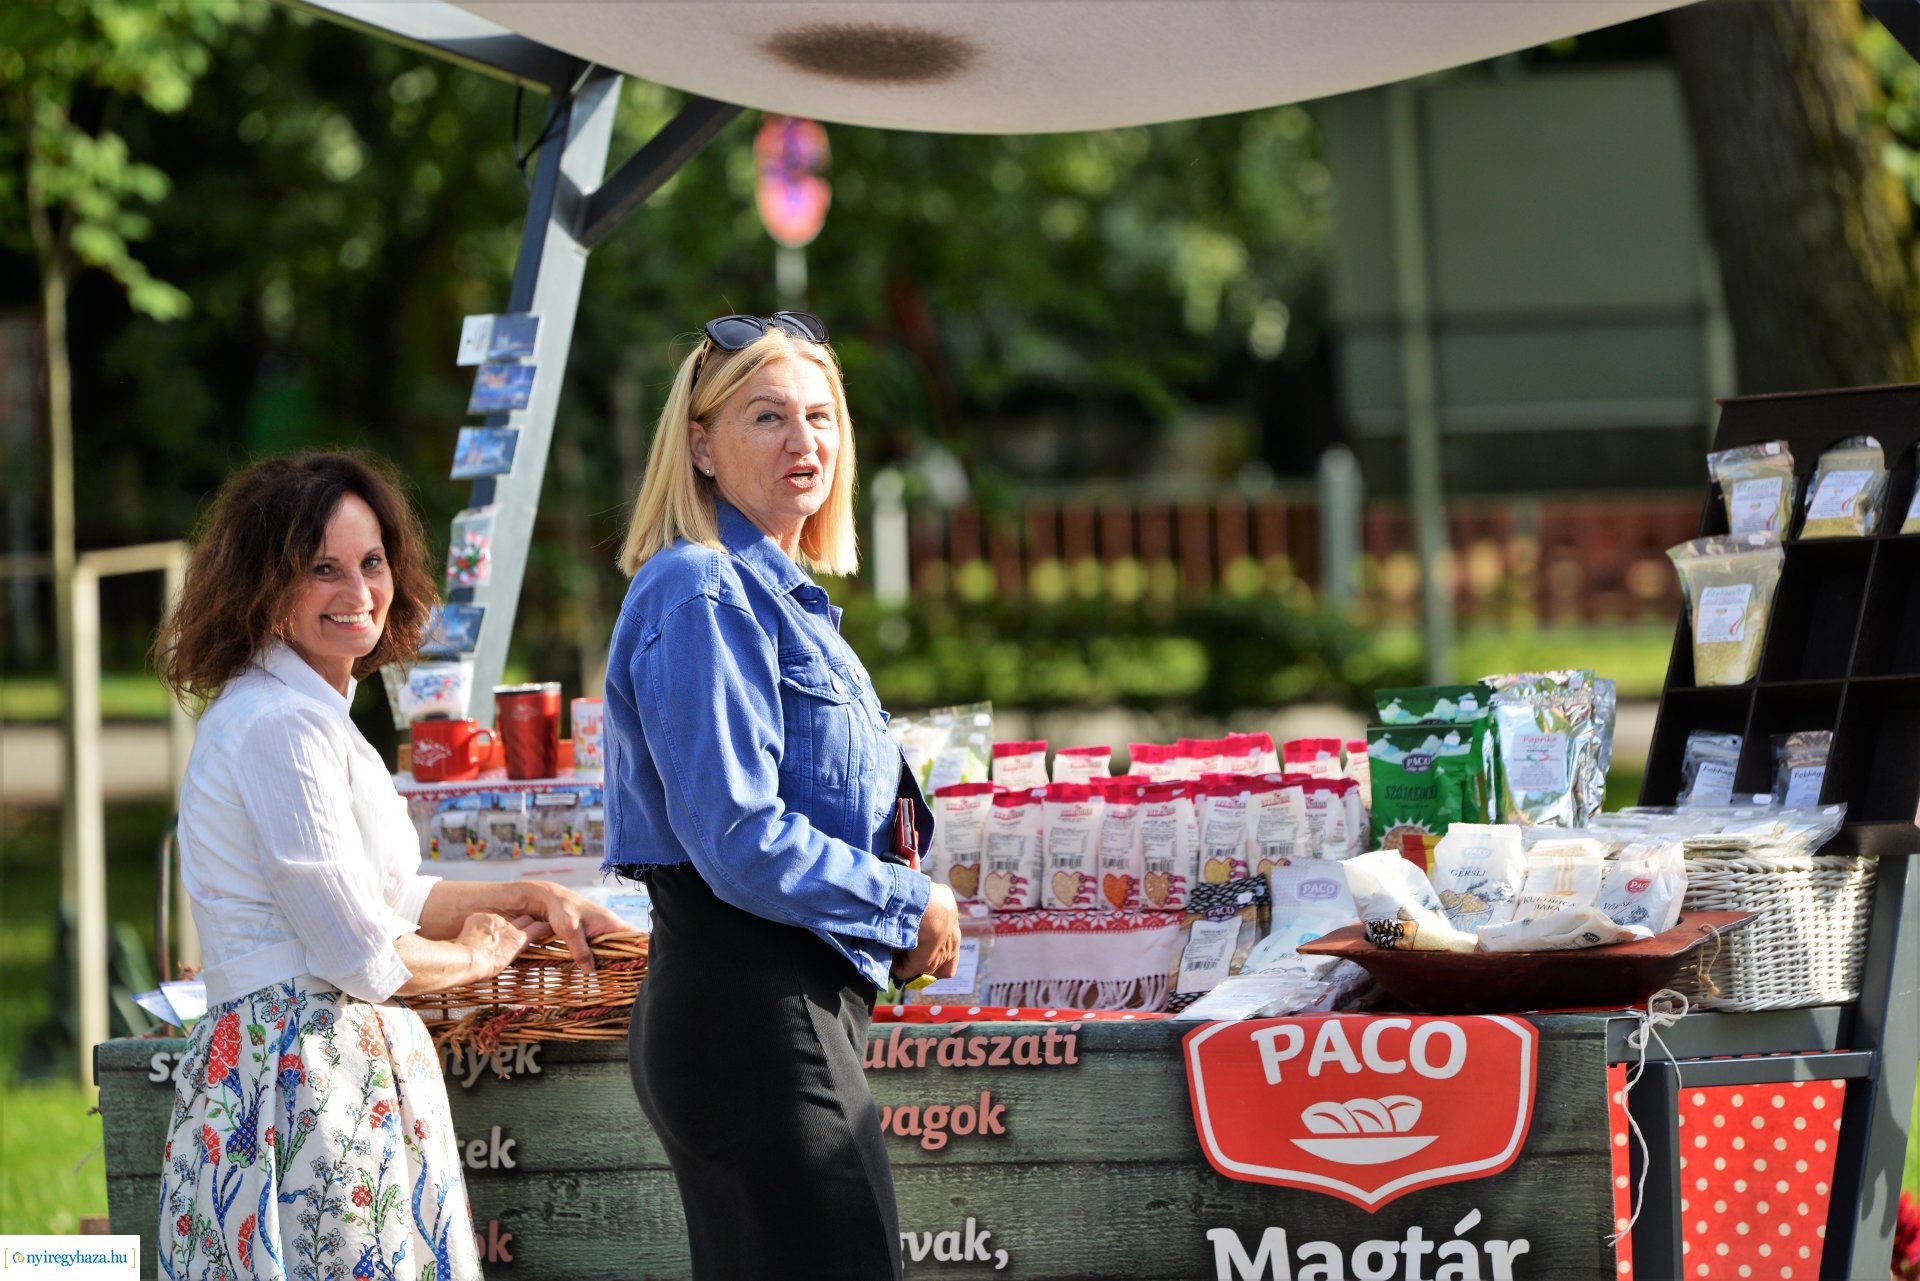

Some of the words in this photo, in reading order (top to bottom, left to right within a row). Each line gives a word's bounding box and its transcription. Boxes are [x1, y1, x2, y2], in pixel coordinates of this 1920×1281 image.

[1406, 757, 1431, 767] PACO
[1303, 882, 1336, 895] PACO
[441, 1041, 542, 1089] nyek
[863, 1023, 1082, 1069] ukrászati
[1250, 1018, 1468, 1086] PACO
[1206, 1207, 1530, 1281] Magtár
